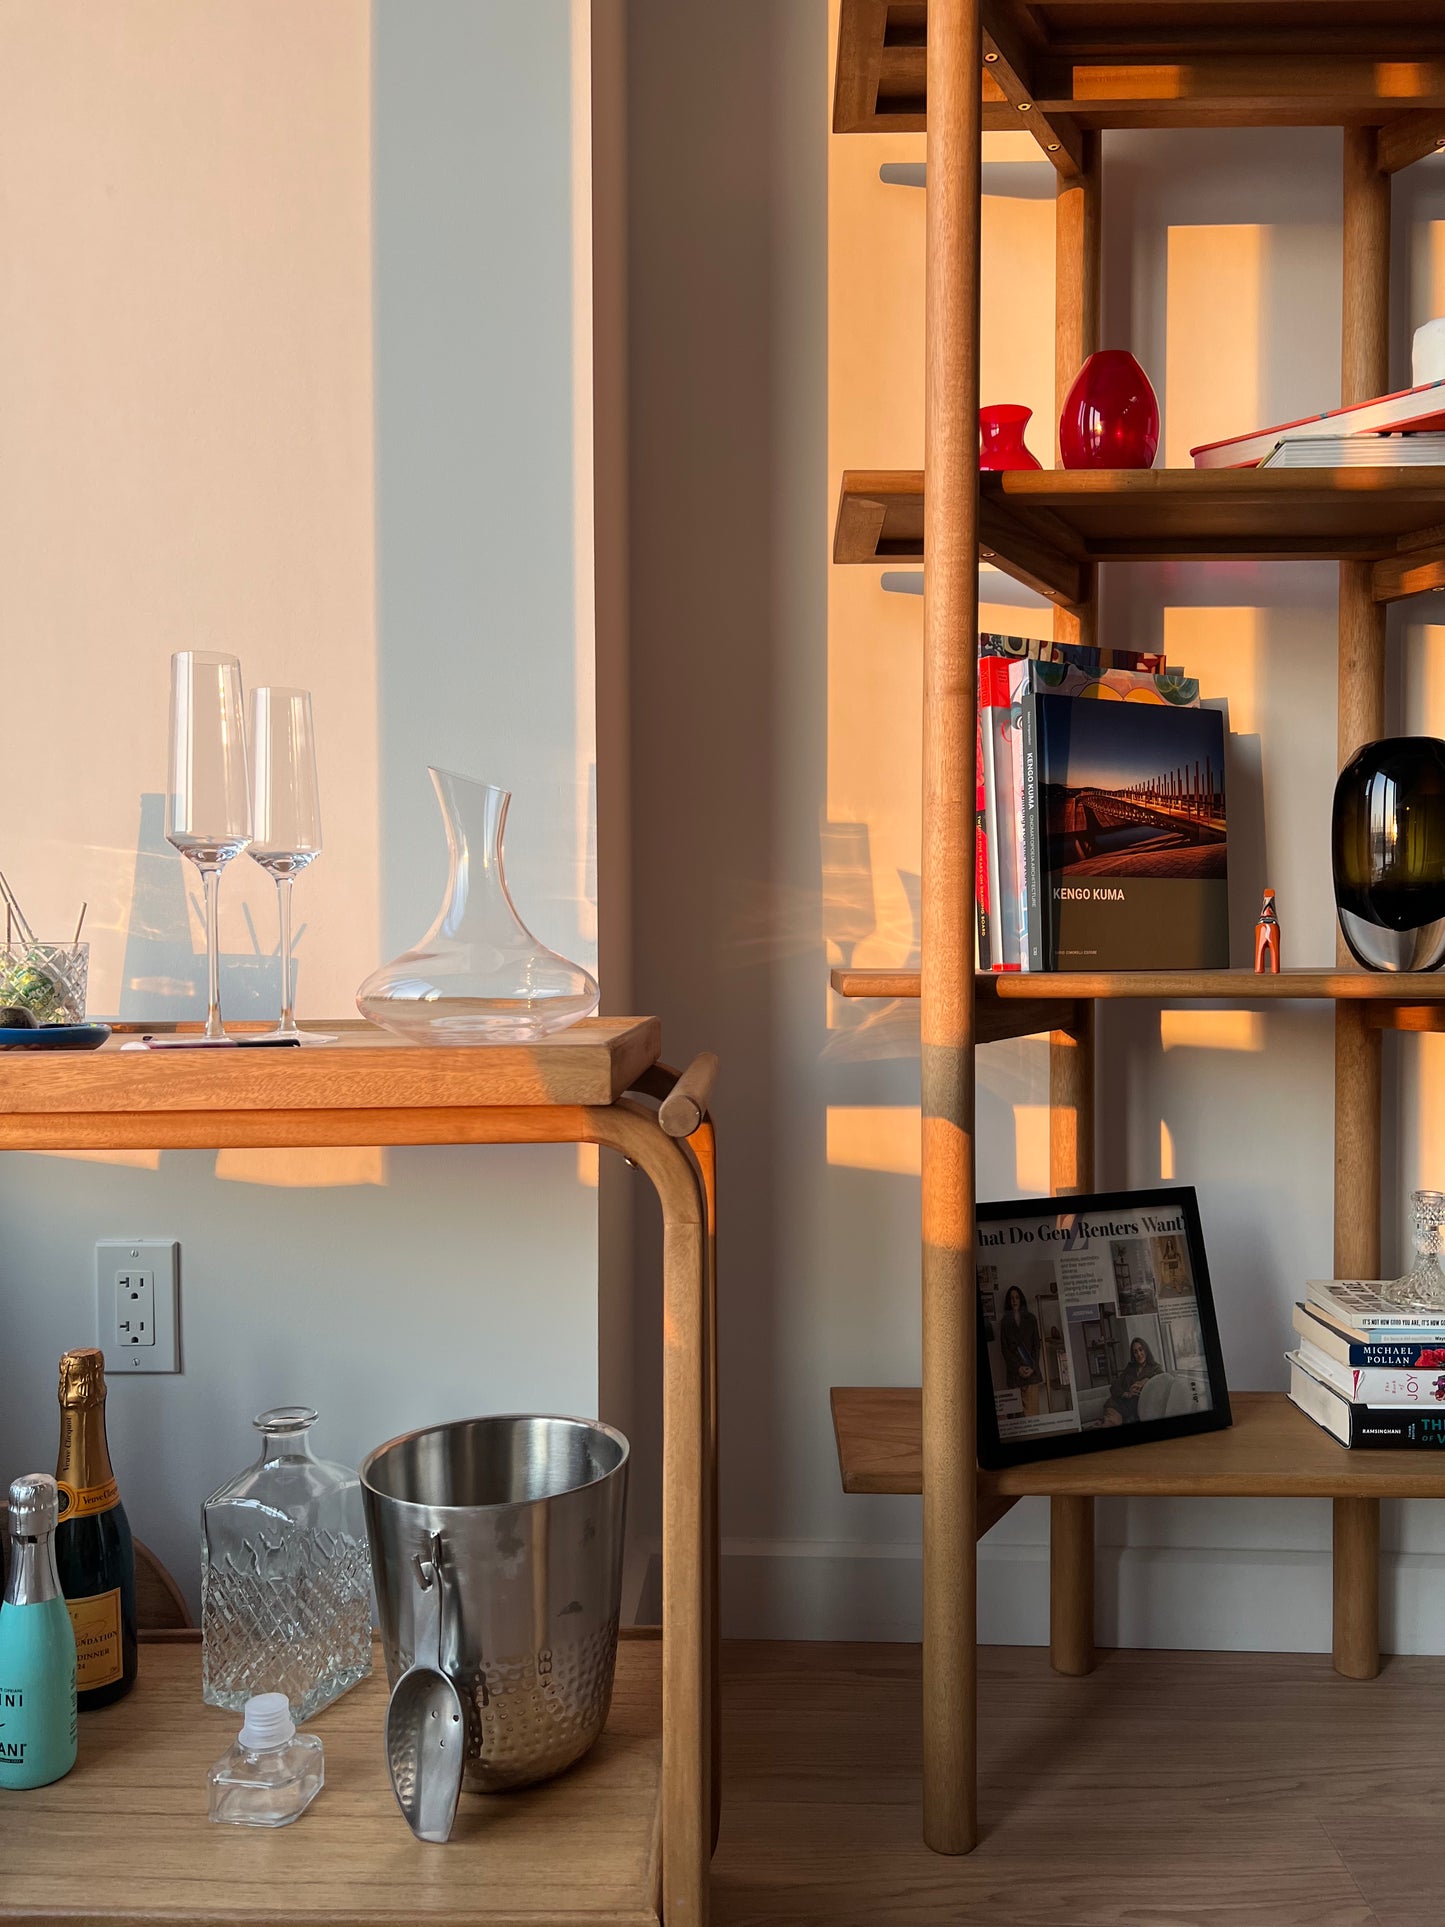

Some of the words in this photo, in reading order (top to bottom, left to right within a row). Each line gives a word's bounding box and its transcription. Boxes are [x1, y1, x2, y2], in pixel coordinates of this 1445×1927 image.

[1054, 888, 1090, 900] KENGO
[1093, 888, 1125, 900] KUMA
[976, 1228, 1006, 1246] hat
[1008, 1226, 1034, 1244] Do
[1038, 1225, 1071, 1242] Gen
[1078, 1221, 1139, 1239] Renters
[1141, 1216, 1184, 1232] Want
[1411, 1319, 1420, 1327] ARE,
[1406, 1374, 1418, 1400] JOY
[1421, 1418, 1445, 1430] TH
[62, 1450, 71, 1472] Veuve
[83, 1493, 103, 1505] Veuve
[77, 1648, 109, 1661] DINNER
